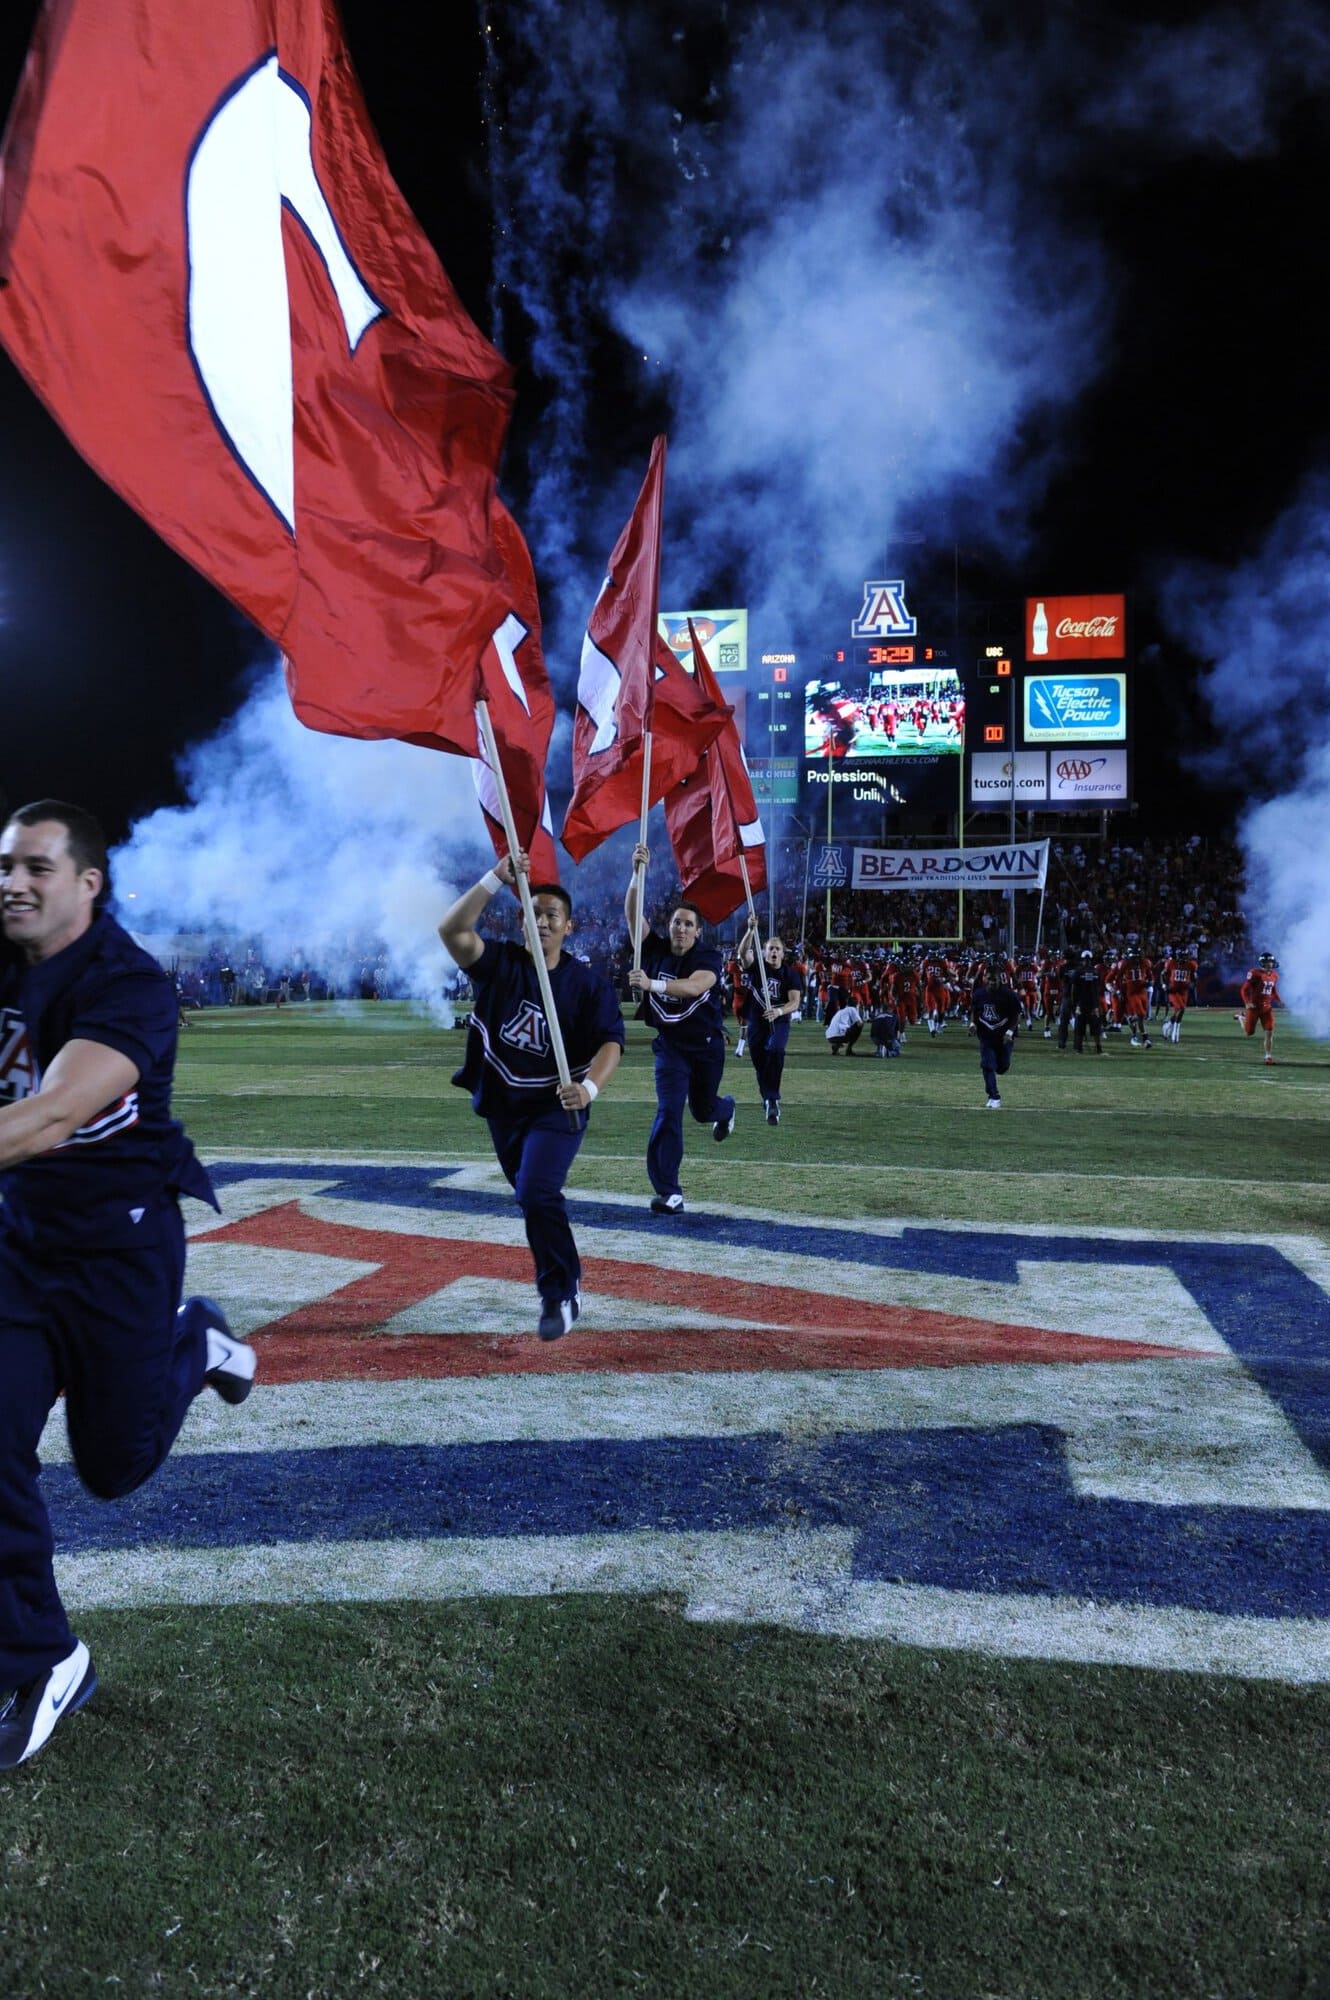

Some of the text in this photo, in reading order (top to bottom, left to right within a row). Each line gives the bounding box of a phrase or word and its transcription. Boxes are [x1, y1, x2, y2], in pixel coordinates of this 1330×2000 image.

[851, 580, 917, 638] A
[1055, 616, 1118, 638] Coca-Cola
[675, 630, 708, 644] NCA
[836, 650, 845, 662] 3
[868, 646, 914, 664] 3:29
[925, 648, 933, 660] 3
[986, 647, 1003, 657] USC
[762, 654, 796, 665] ARIZONA
[997, 660, 1011, 675] 0
[1052, 684, 1099, 698] Tucson
[1057, 697, 1112, 709] Electric
[1062, 709, 1111, 721] Power
[1060, 759, 1090, 781] AAA
[974, 777, 1045, 789] tucson.com
[1074, 783, 1122, 792] Insurance
[814, 846, 847, 877] A
[813, 878, 846, 887] CLUB
[926, 874, 965, 882] TRADITION
[967, 873, 988, 881] LIVES
[499, 999, 550, 1058] A
